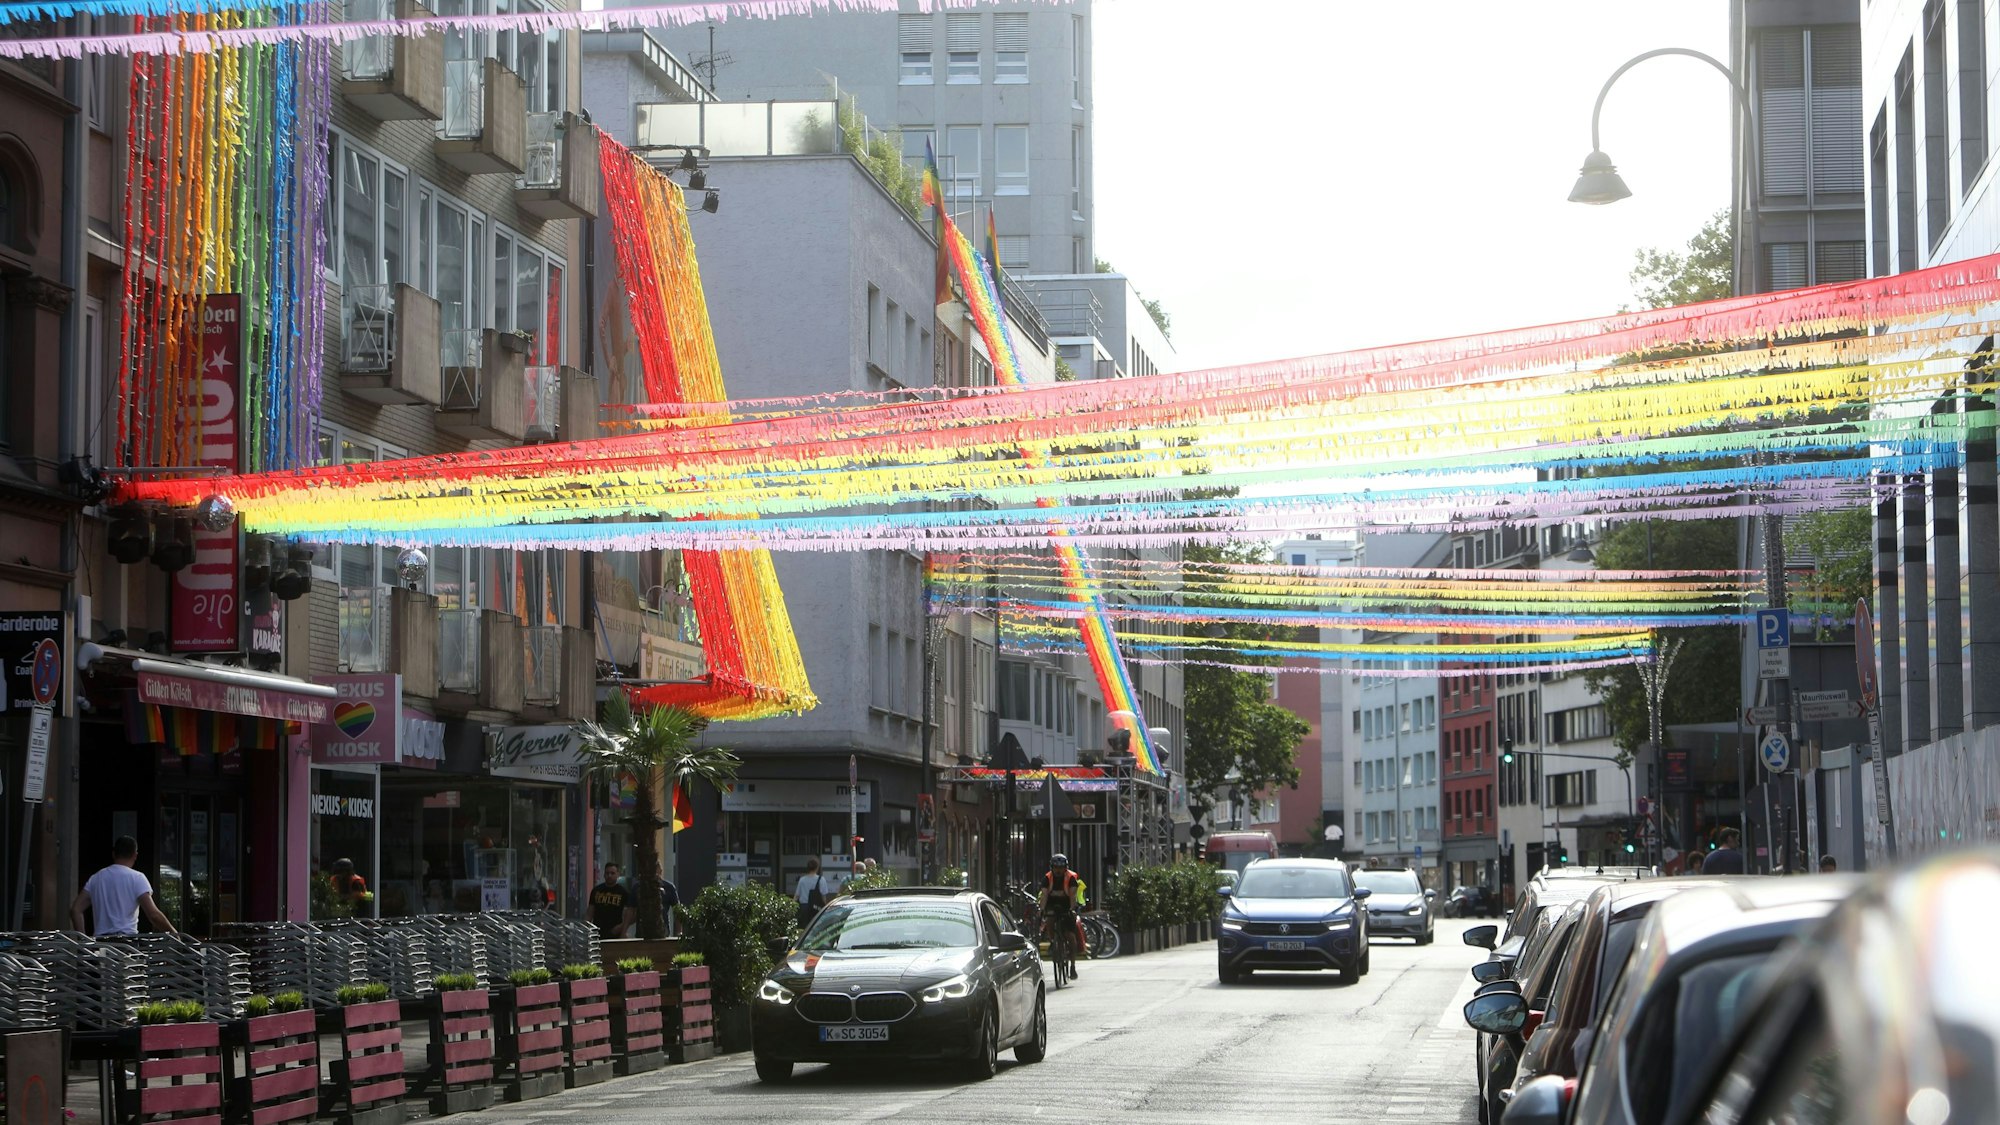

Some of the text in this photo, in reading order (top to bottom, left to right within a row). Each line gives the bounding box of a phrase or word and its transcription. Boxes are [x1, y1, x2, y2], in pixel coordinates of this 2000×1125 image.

[190, 324, 222, 334] Klsch
[146, 679, 192, 702] Gilden Kölsch
[1801, 692, 1846, 702] Mauritiuswall
[288, 699, 327, 720] Gilden Kölsch
[326, 742, 381, 757] KIOSK
[311, 794, 373, 818] NEXUS KIOSK
[826, 1028, 887, 1039] K SC 3054
